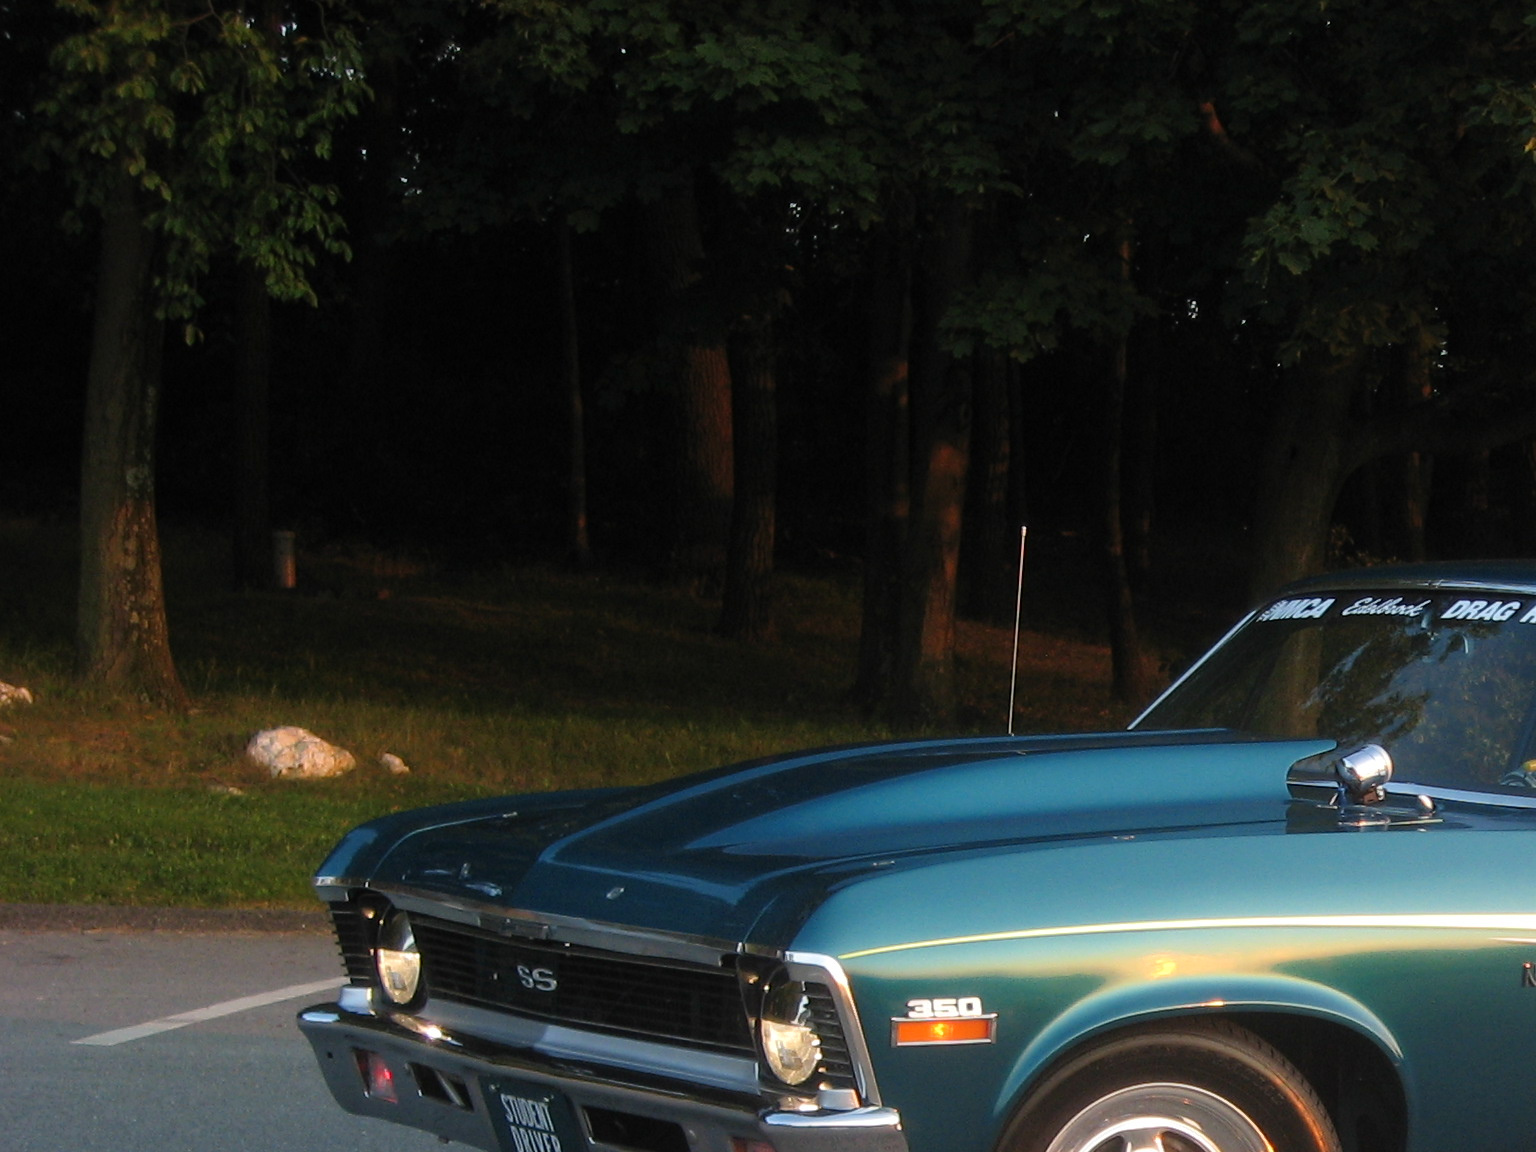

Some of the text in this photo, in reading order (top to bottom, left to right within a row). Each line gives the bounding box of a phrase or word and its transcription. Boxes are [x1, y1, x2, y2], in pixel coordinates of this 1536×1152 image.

[1441, 600, 1521, 621] DRAG
[517, 965, 558, 991] SS
[907, 996, 982, 1018] 350
[500, 1093, 555, 1133] STUDENT
